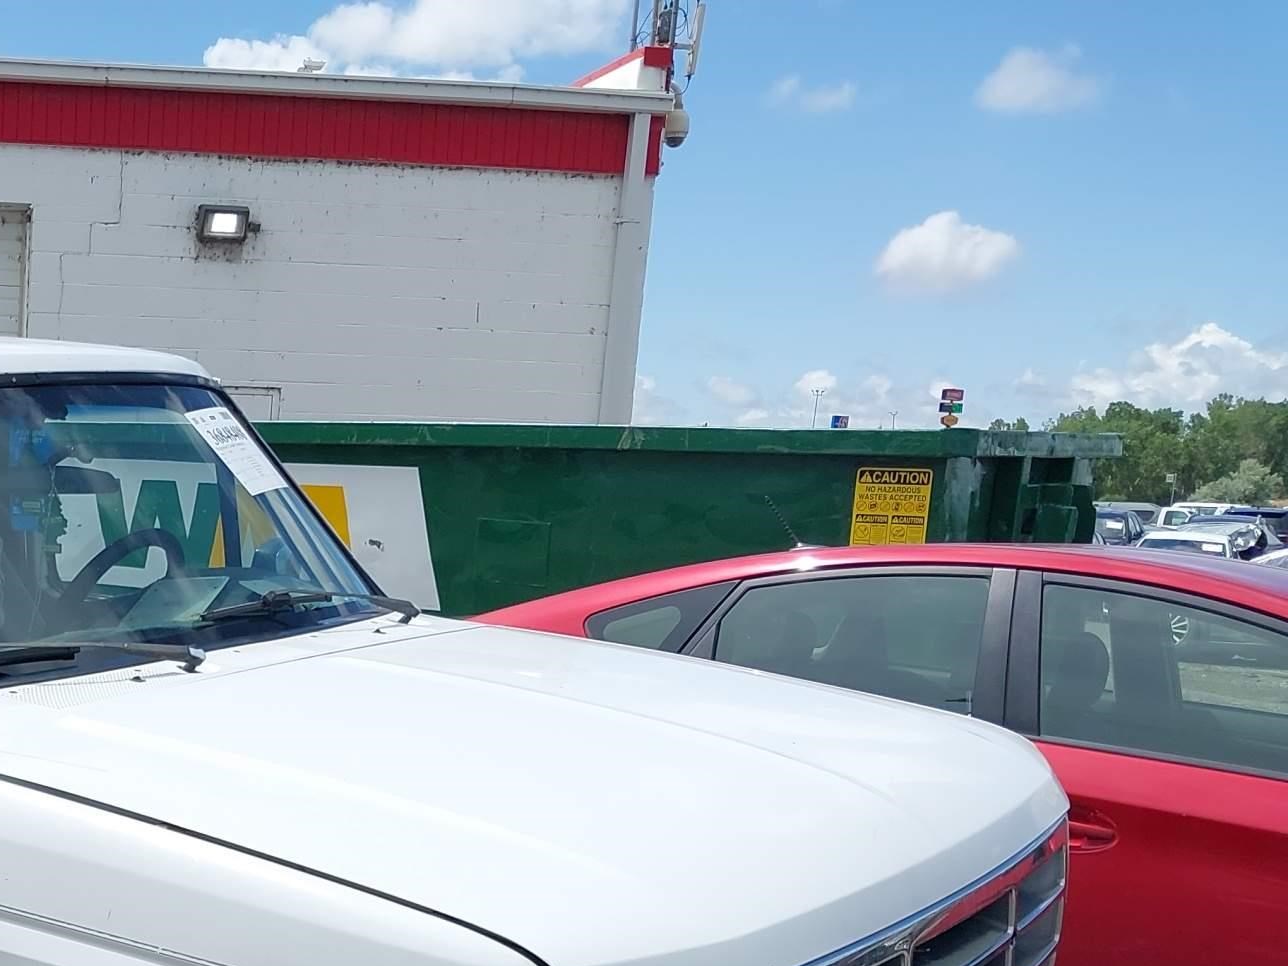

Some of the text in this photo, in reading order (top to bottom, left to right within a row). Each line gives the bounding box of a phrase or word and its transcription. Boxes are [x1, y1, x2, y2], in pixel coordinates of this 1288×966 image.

[872, 471, 929, 484] CAUTION
[877, 486, 921, 494] HAZARDOUS
[889, 494, 927, 502] ACCEPTED
